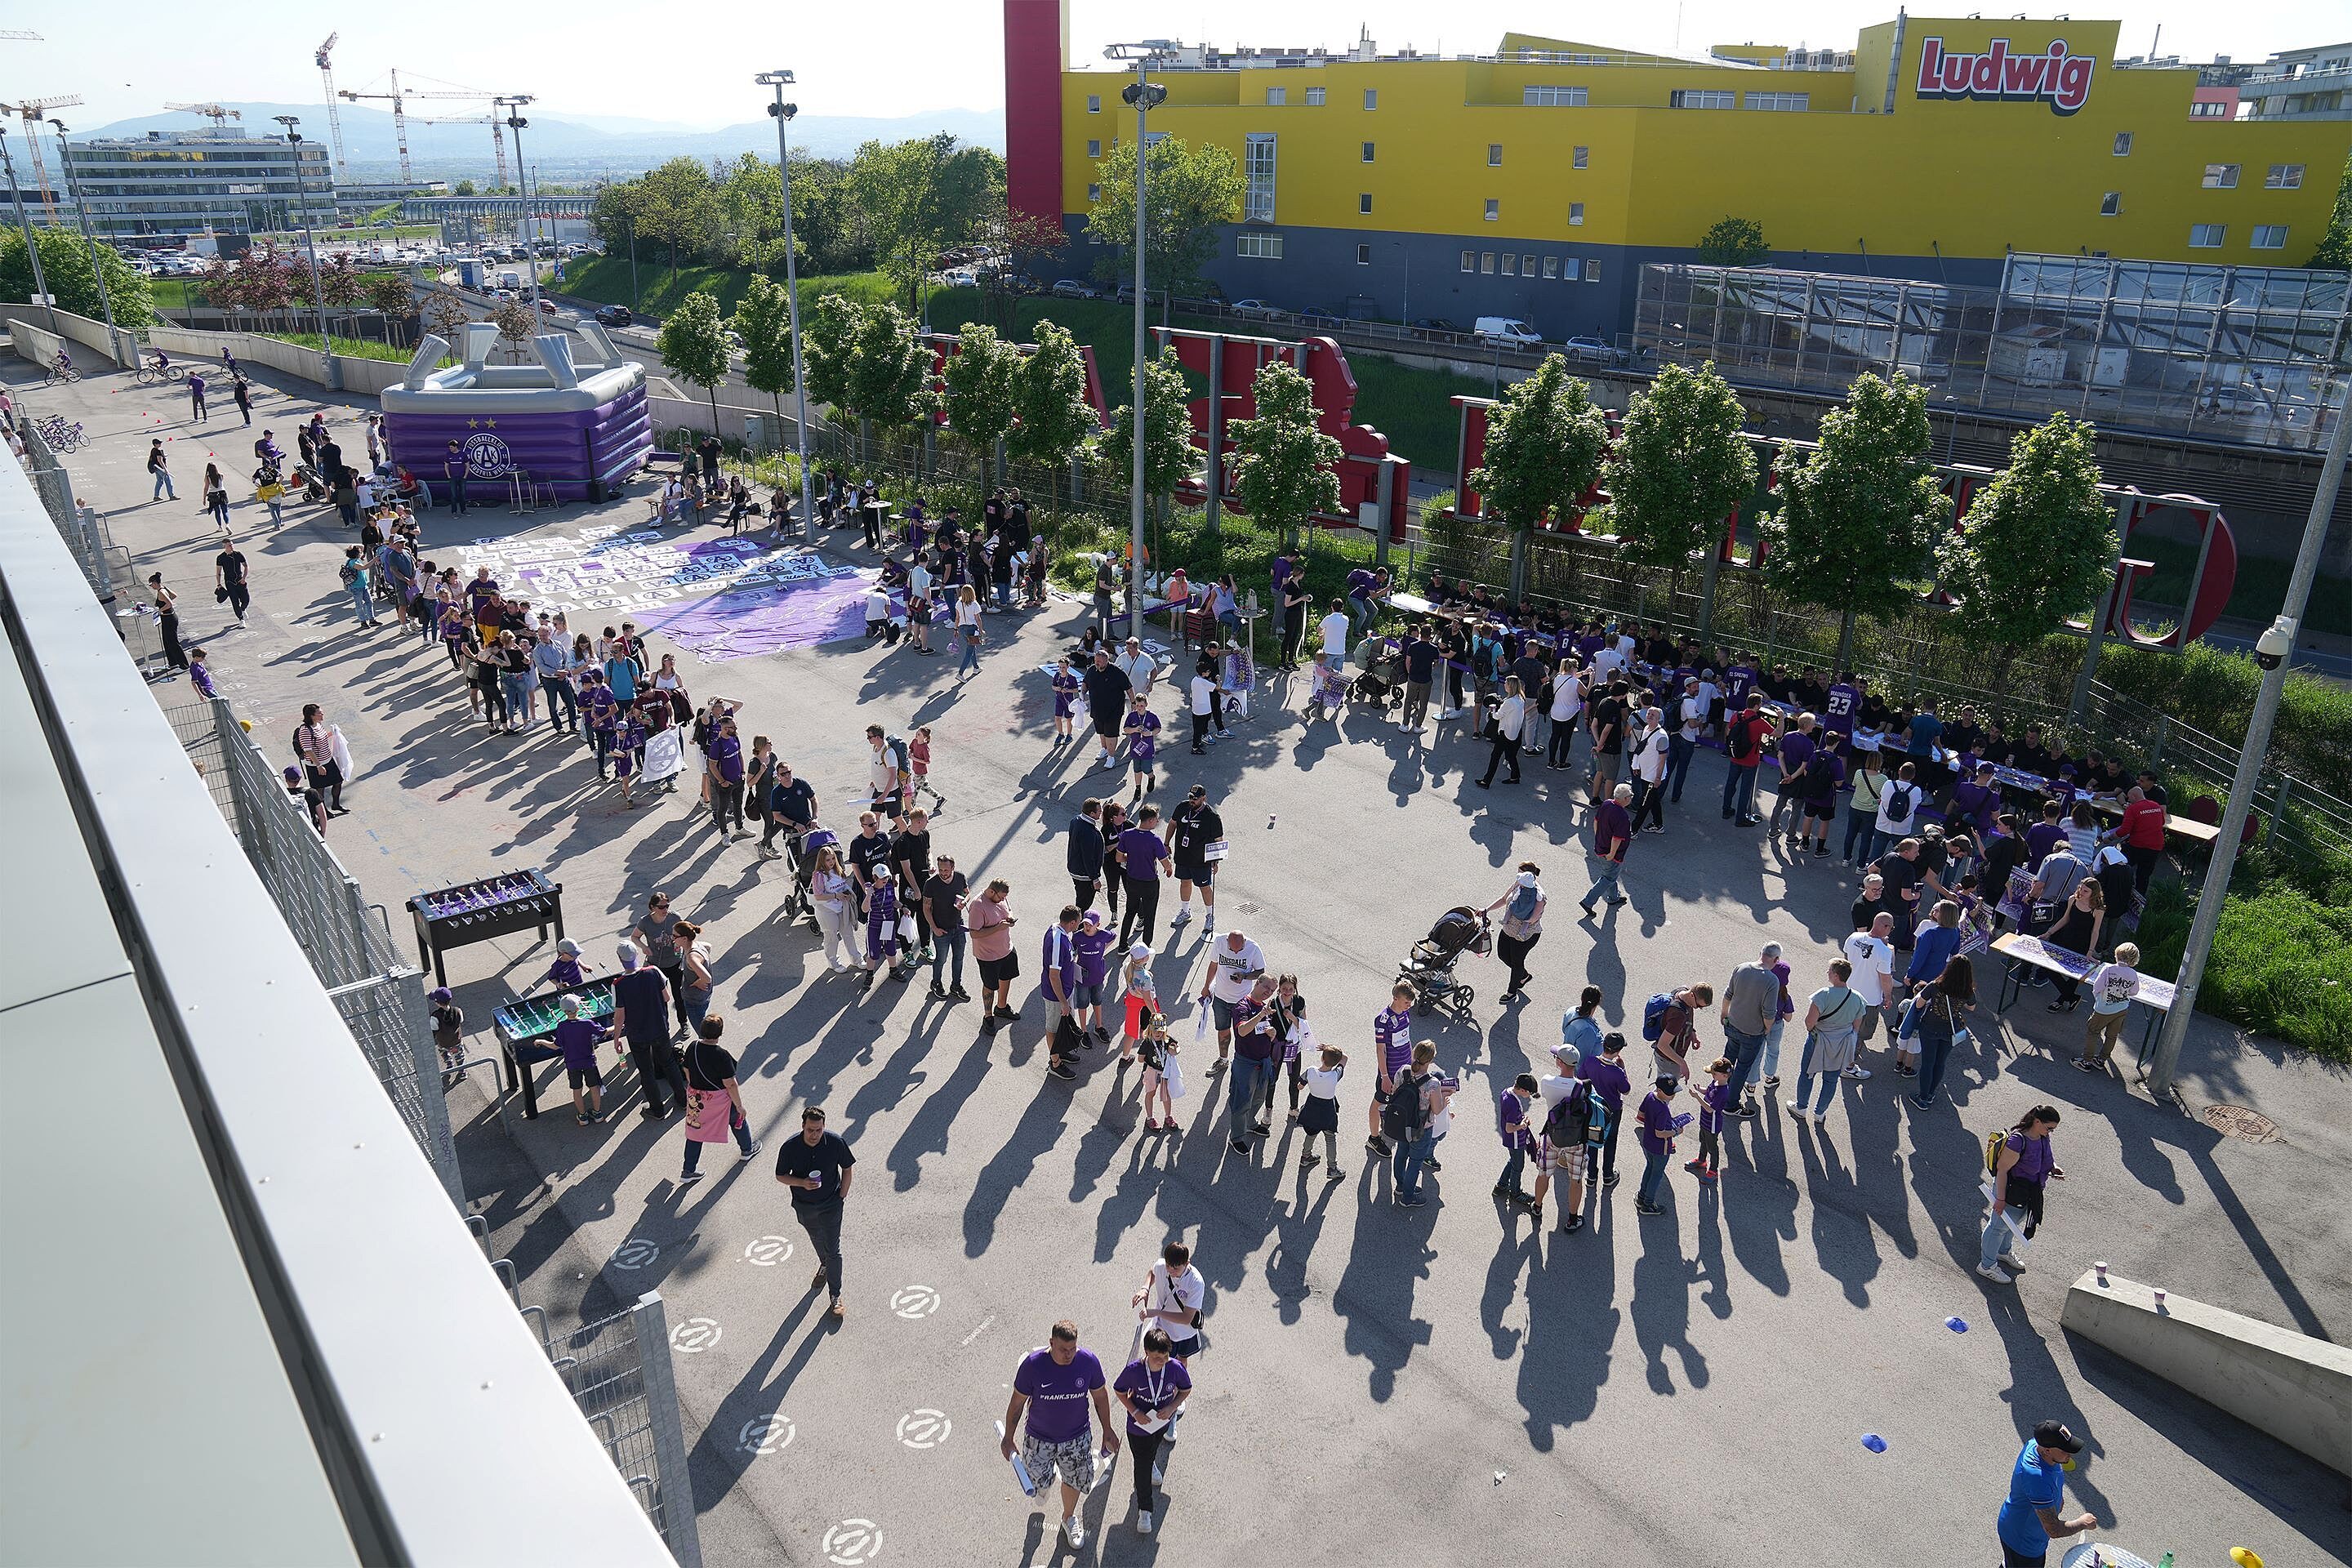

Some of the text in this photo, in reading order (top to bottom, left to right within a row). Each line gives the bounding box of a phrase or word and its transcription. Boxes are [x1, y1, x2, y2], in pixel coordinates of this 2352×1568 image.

[1916, 37, 2096, 111] Ludwig
[1828, 697, 1852, 715] 23
[1208, 843, 1223, 852] STATION
[1219, 954, 1247, 970] LONSDALE
